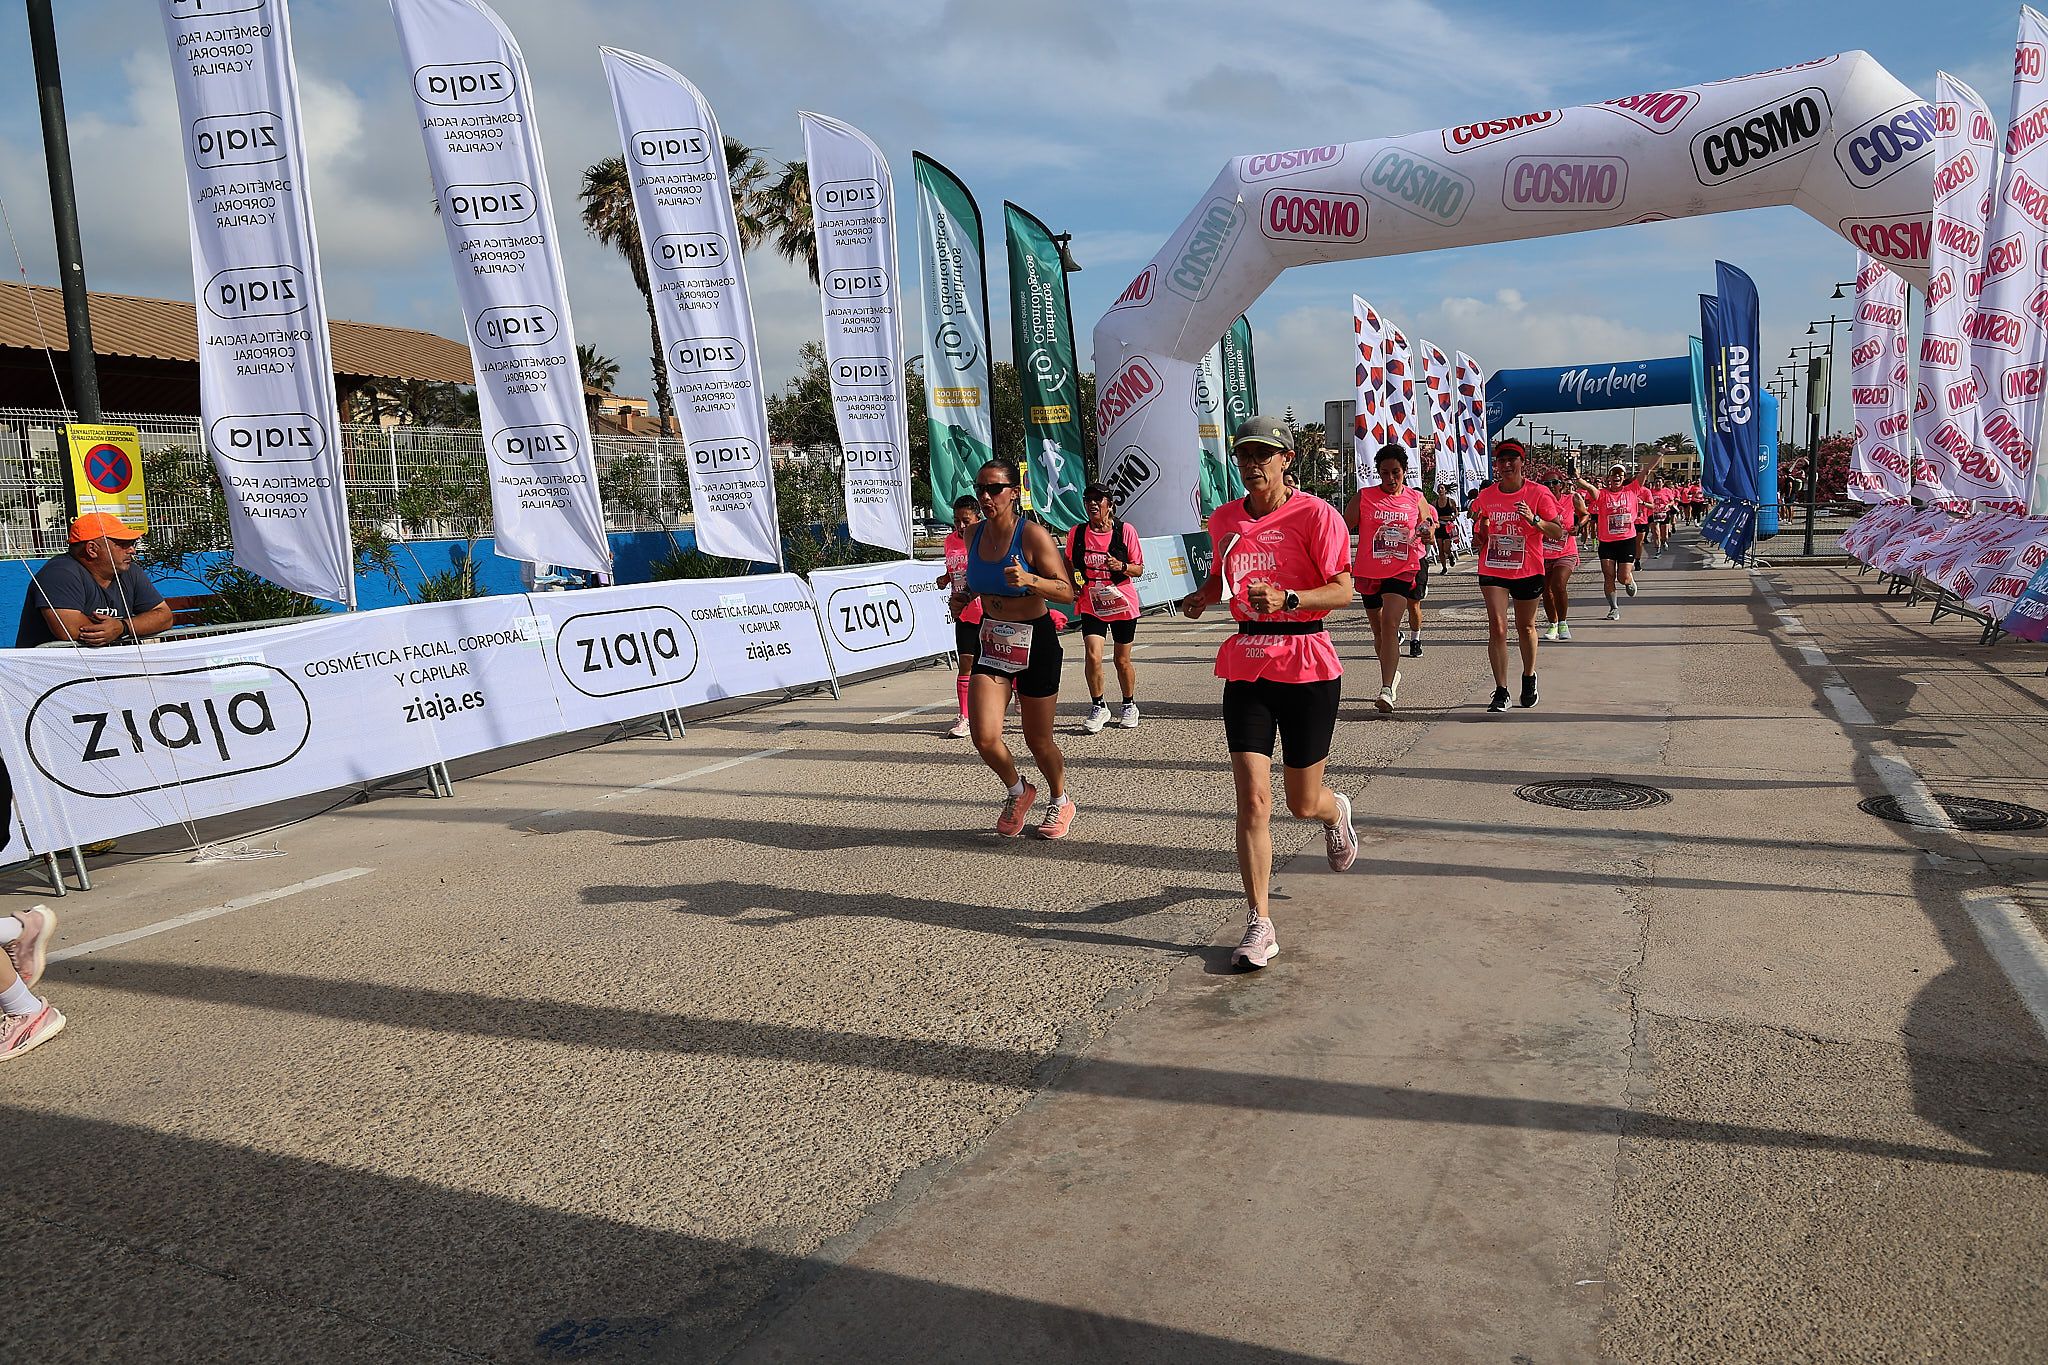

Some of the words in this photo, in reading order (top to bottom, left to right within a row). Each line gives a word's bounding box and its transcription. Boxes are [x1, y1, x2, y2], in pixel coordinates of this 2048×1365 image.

[1452, 111, 1552, 145] COSMO
[1702, 96, 1821, 176] COSMO
[1849, 104, 1936, 176] COSM
[1249, 145, 1337, 176] COSMO
[1371, 152, 1464, 219] COSMO
[1513, 162, 1618, 204] COSMO
[1270, 196, 1360, 237] COSMO
[1173, 205, 1238, 292] COSMO
[1850, 221, 1933, 260] COSM
[1559, 366, 1648, 405] Marlene
[1374, 510, 1409, 521] CARRERA
[2021, 542, 2046, 568] COS
[1986, 577, 2027, 598] COSMO
[691, 605, 742, 621] COSMÉTICA
[742, 603, 772, 616] FACIAL,
[739, 624, 746, 634] Y
[746, 620, 782, 633] CAPILAR
[840, 598, 903, 636] ziaja
[304, 645, 401, 678] COSMÉTICA
[402, 640, 456, 662] FACIAL,
[458, 628, 528, 652] CORPORAL
[576, 625, 680, 677] ziaja
[746, 640, 792, 662] ziaja.es
[995, 644, 1012, 653] 016
[1246, 648, 1265, 658] 2026
[394, 673, 407, 688] Y
[409, 662, 470, 686] CAPILAR
[402, 687, 485, 724] ziaja.es
[72, 690, 277, 762] ziaja
